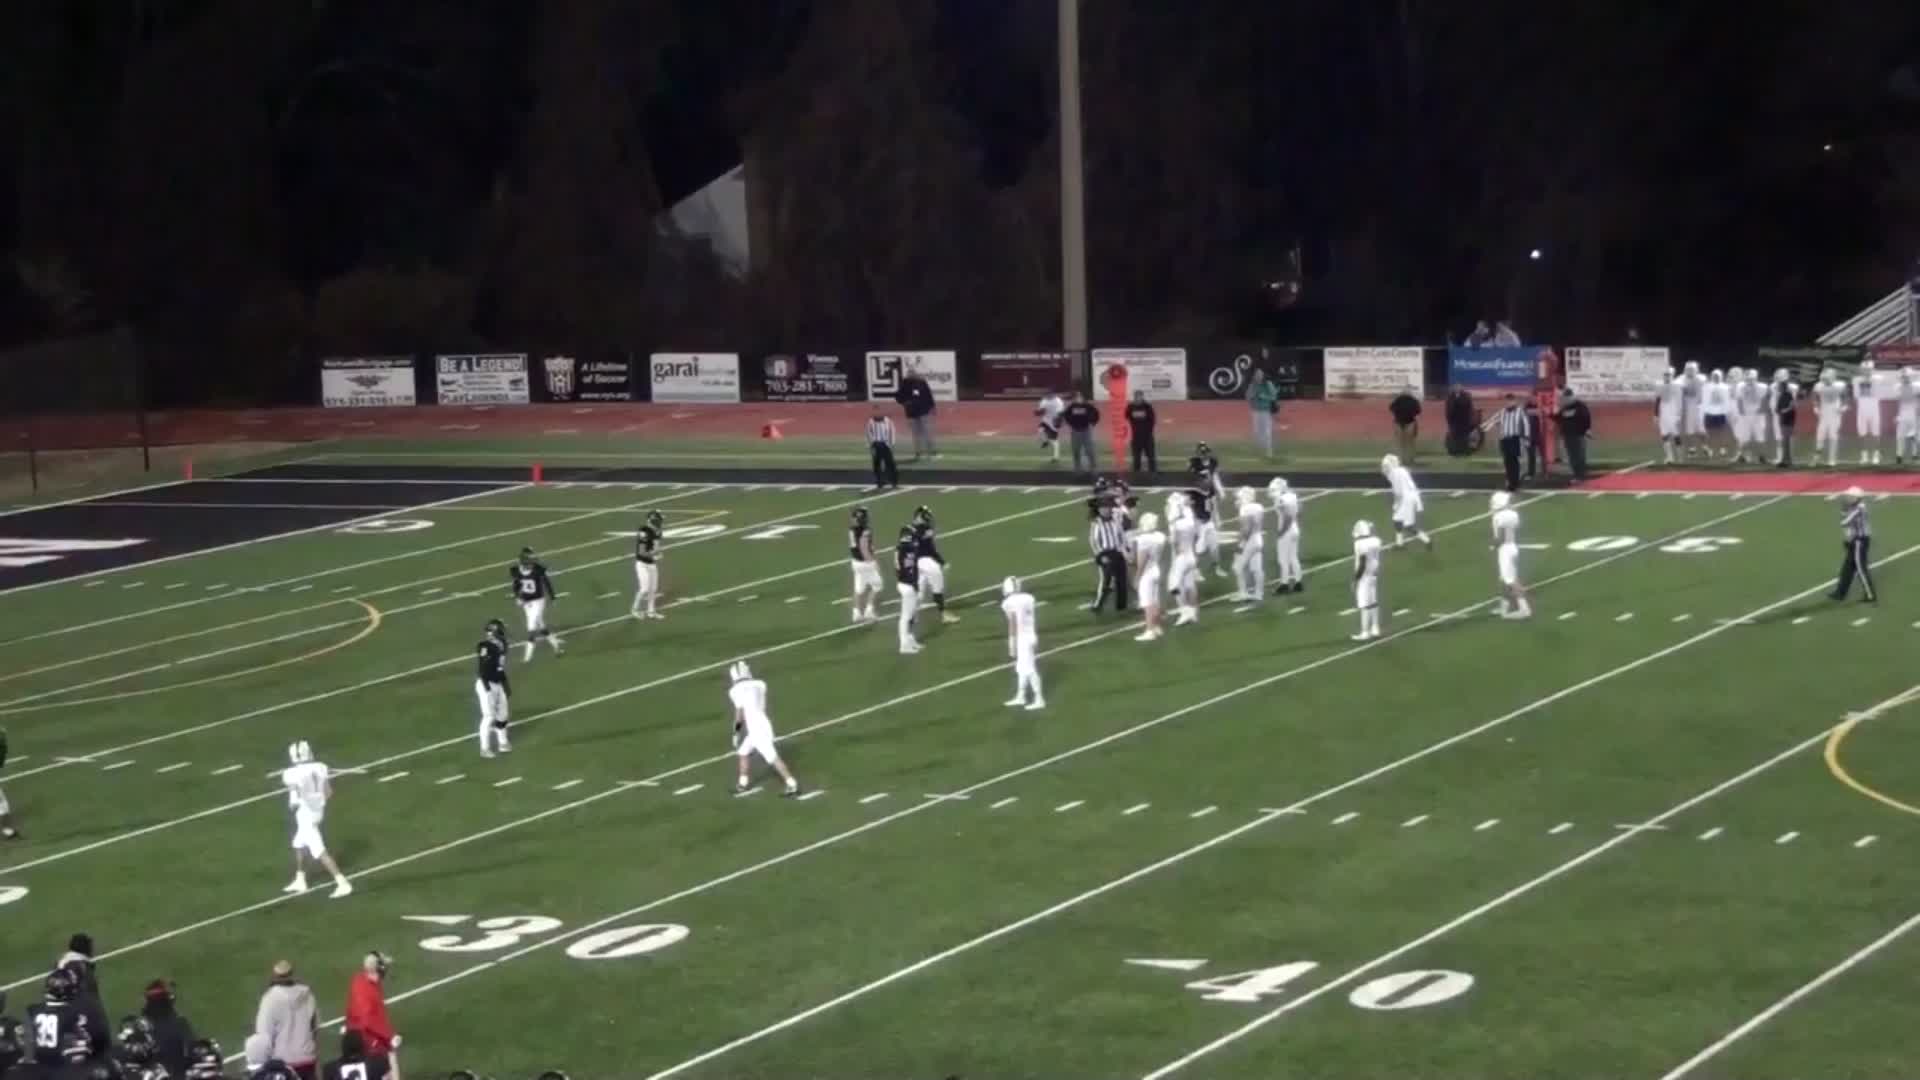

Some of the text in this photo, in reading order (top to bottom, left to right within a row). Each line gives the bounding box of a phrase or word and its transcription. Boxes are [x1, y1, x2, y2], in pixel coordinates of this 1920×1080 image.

[439, 357, 457, 372] BE
[460, 359, 469, 372] A
[653, 355, 700, 383] garai
[418, 915, 690, 959] 30
[1184, 960, 1475, 1010] 40
[34, 1013, 59, 1049] 39
